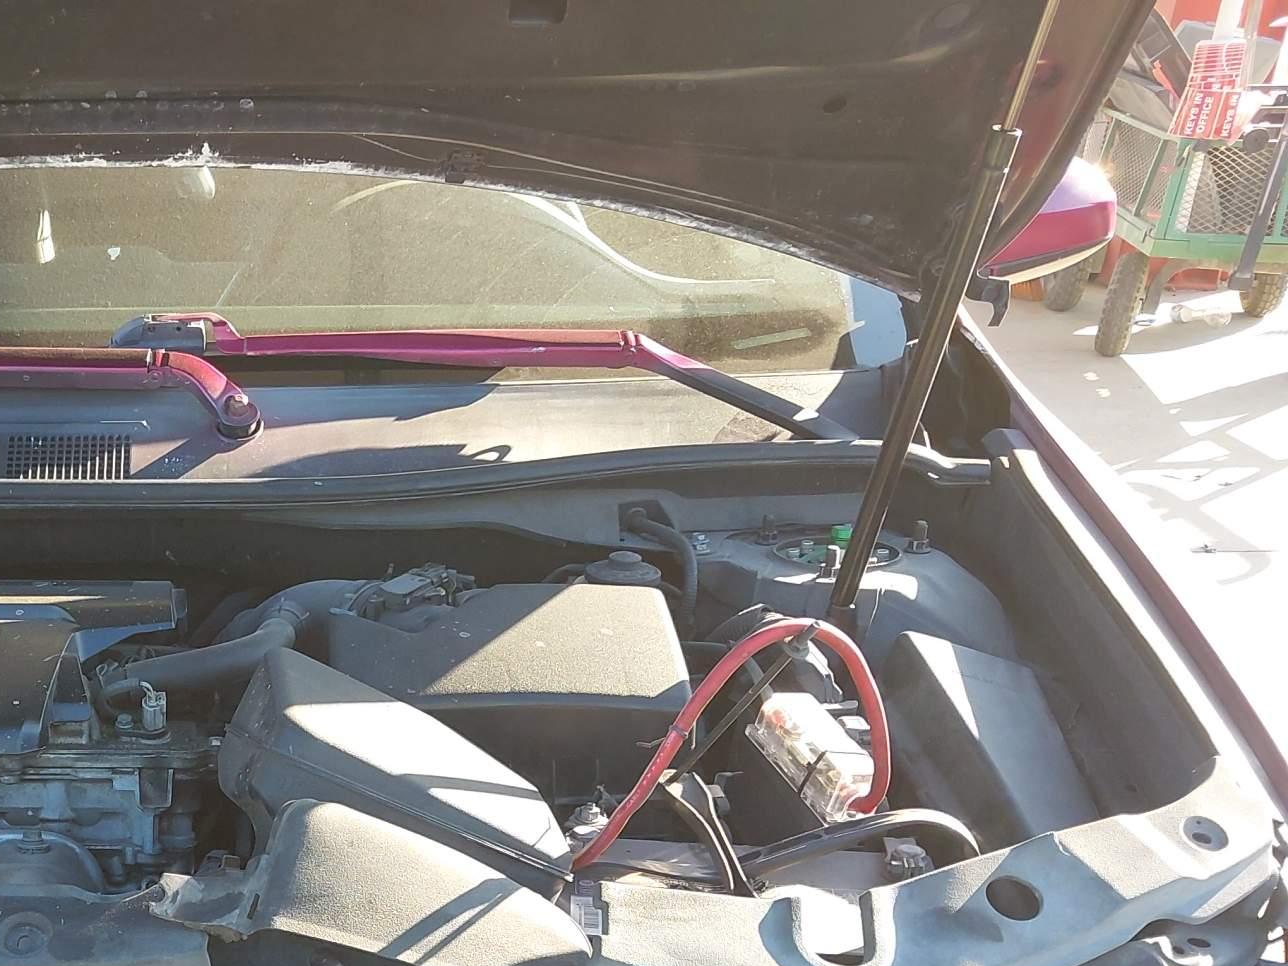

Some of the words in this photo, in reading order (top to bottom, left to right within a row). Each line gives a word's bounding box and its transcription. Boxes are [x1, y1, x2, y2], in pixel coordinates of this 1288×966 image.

[1183, 107, 1199, 135] KEYS
[1193, 92, 1204, 105] IN
[1196, 96, 1214, 133] OFFICE
[1220, 108, 1235, 137] KEYS
